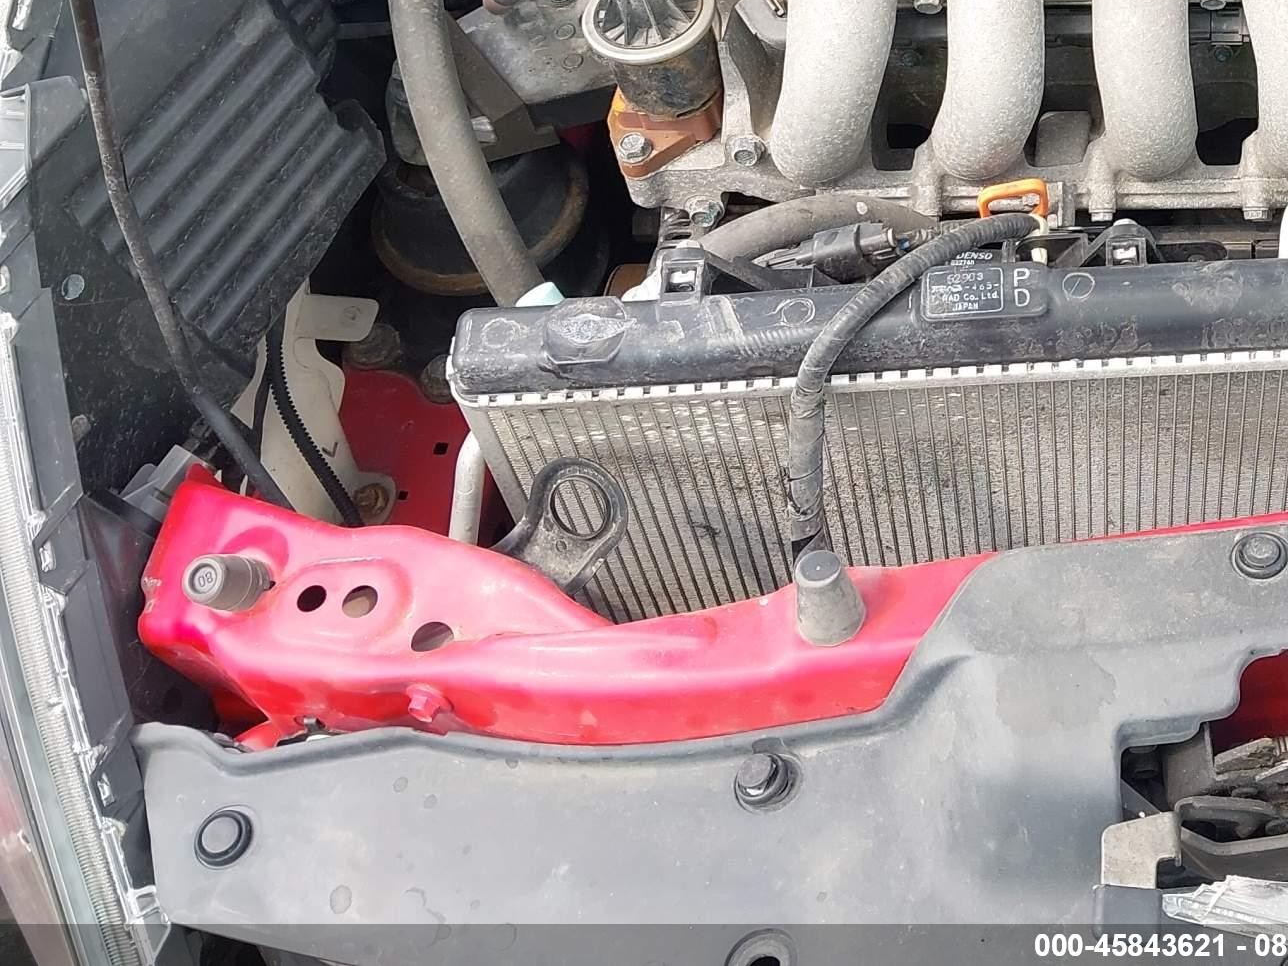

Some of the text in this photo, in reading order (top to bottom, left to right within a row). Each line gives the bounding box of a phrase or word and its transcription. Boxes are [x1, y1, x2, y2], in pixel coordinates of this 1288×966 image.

[1013, 267, 1030, 287] P
[952, 302, 979, 311] JAPAN
[1014, 288, 1030, 307] D
